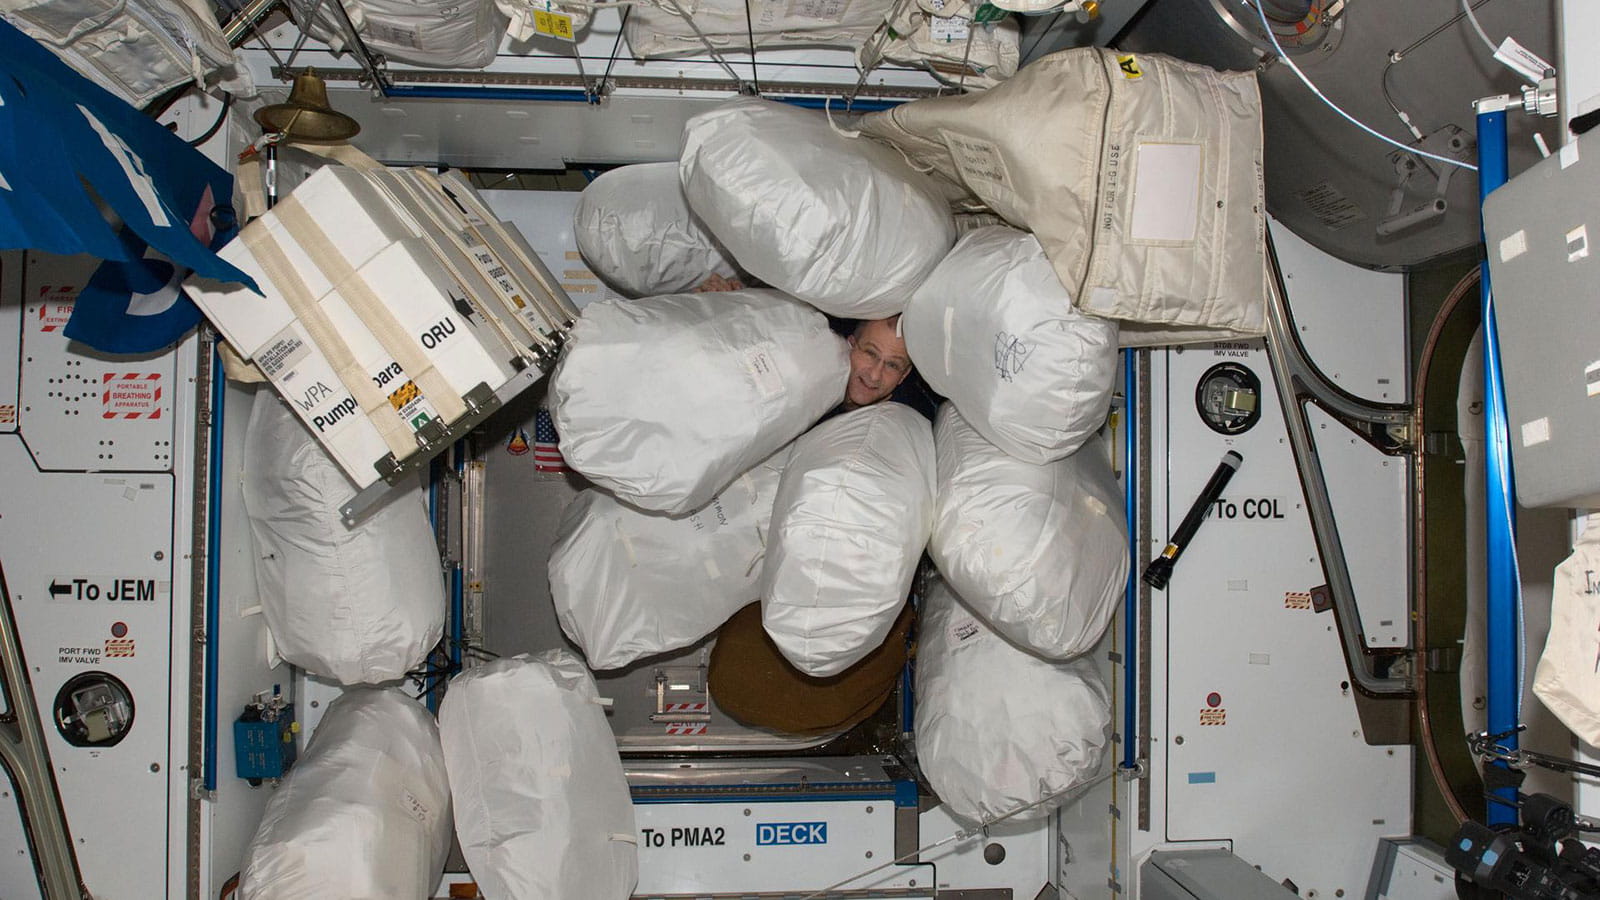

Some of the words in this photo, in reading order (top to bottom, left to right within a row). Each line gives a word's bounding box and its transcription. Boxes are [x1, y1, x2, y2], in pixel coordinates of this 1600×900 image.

[1120, 58, 1139, 75] A
[1110, 145, 1120, 166] USE
[1106, 190, 1115, 209] FOR
[1103, 211, 1113, 230] NOT
[420, 316, 456, 350] ORU
[295, 381, 333, 412] WPA
[1216, 499, 1237, 519] To
[1243, 498, 1284, 519] COL
[73, 579, 100, 601] To
[107, 579, 155, 601] JEM
[83, 648, 101, 656] FWD
[642, 829, 664, 847] To
[671, 827, 725, 847] PMA2
[759, 824, 825, 844] DECK
